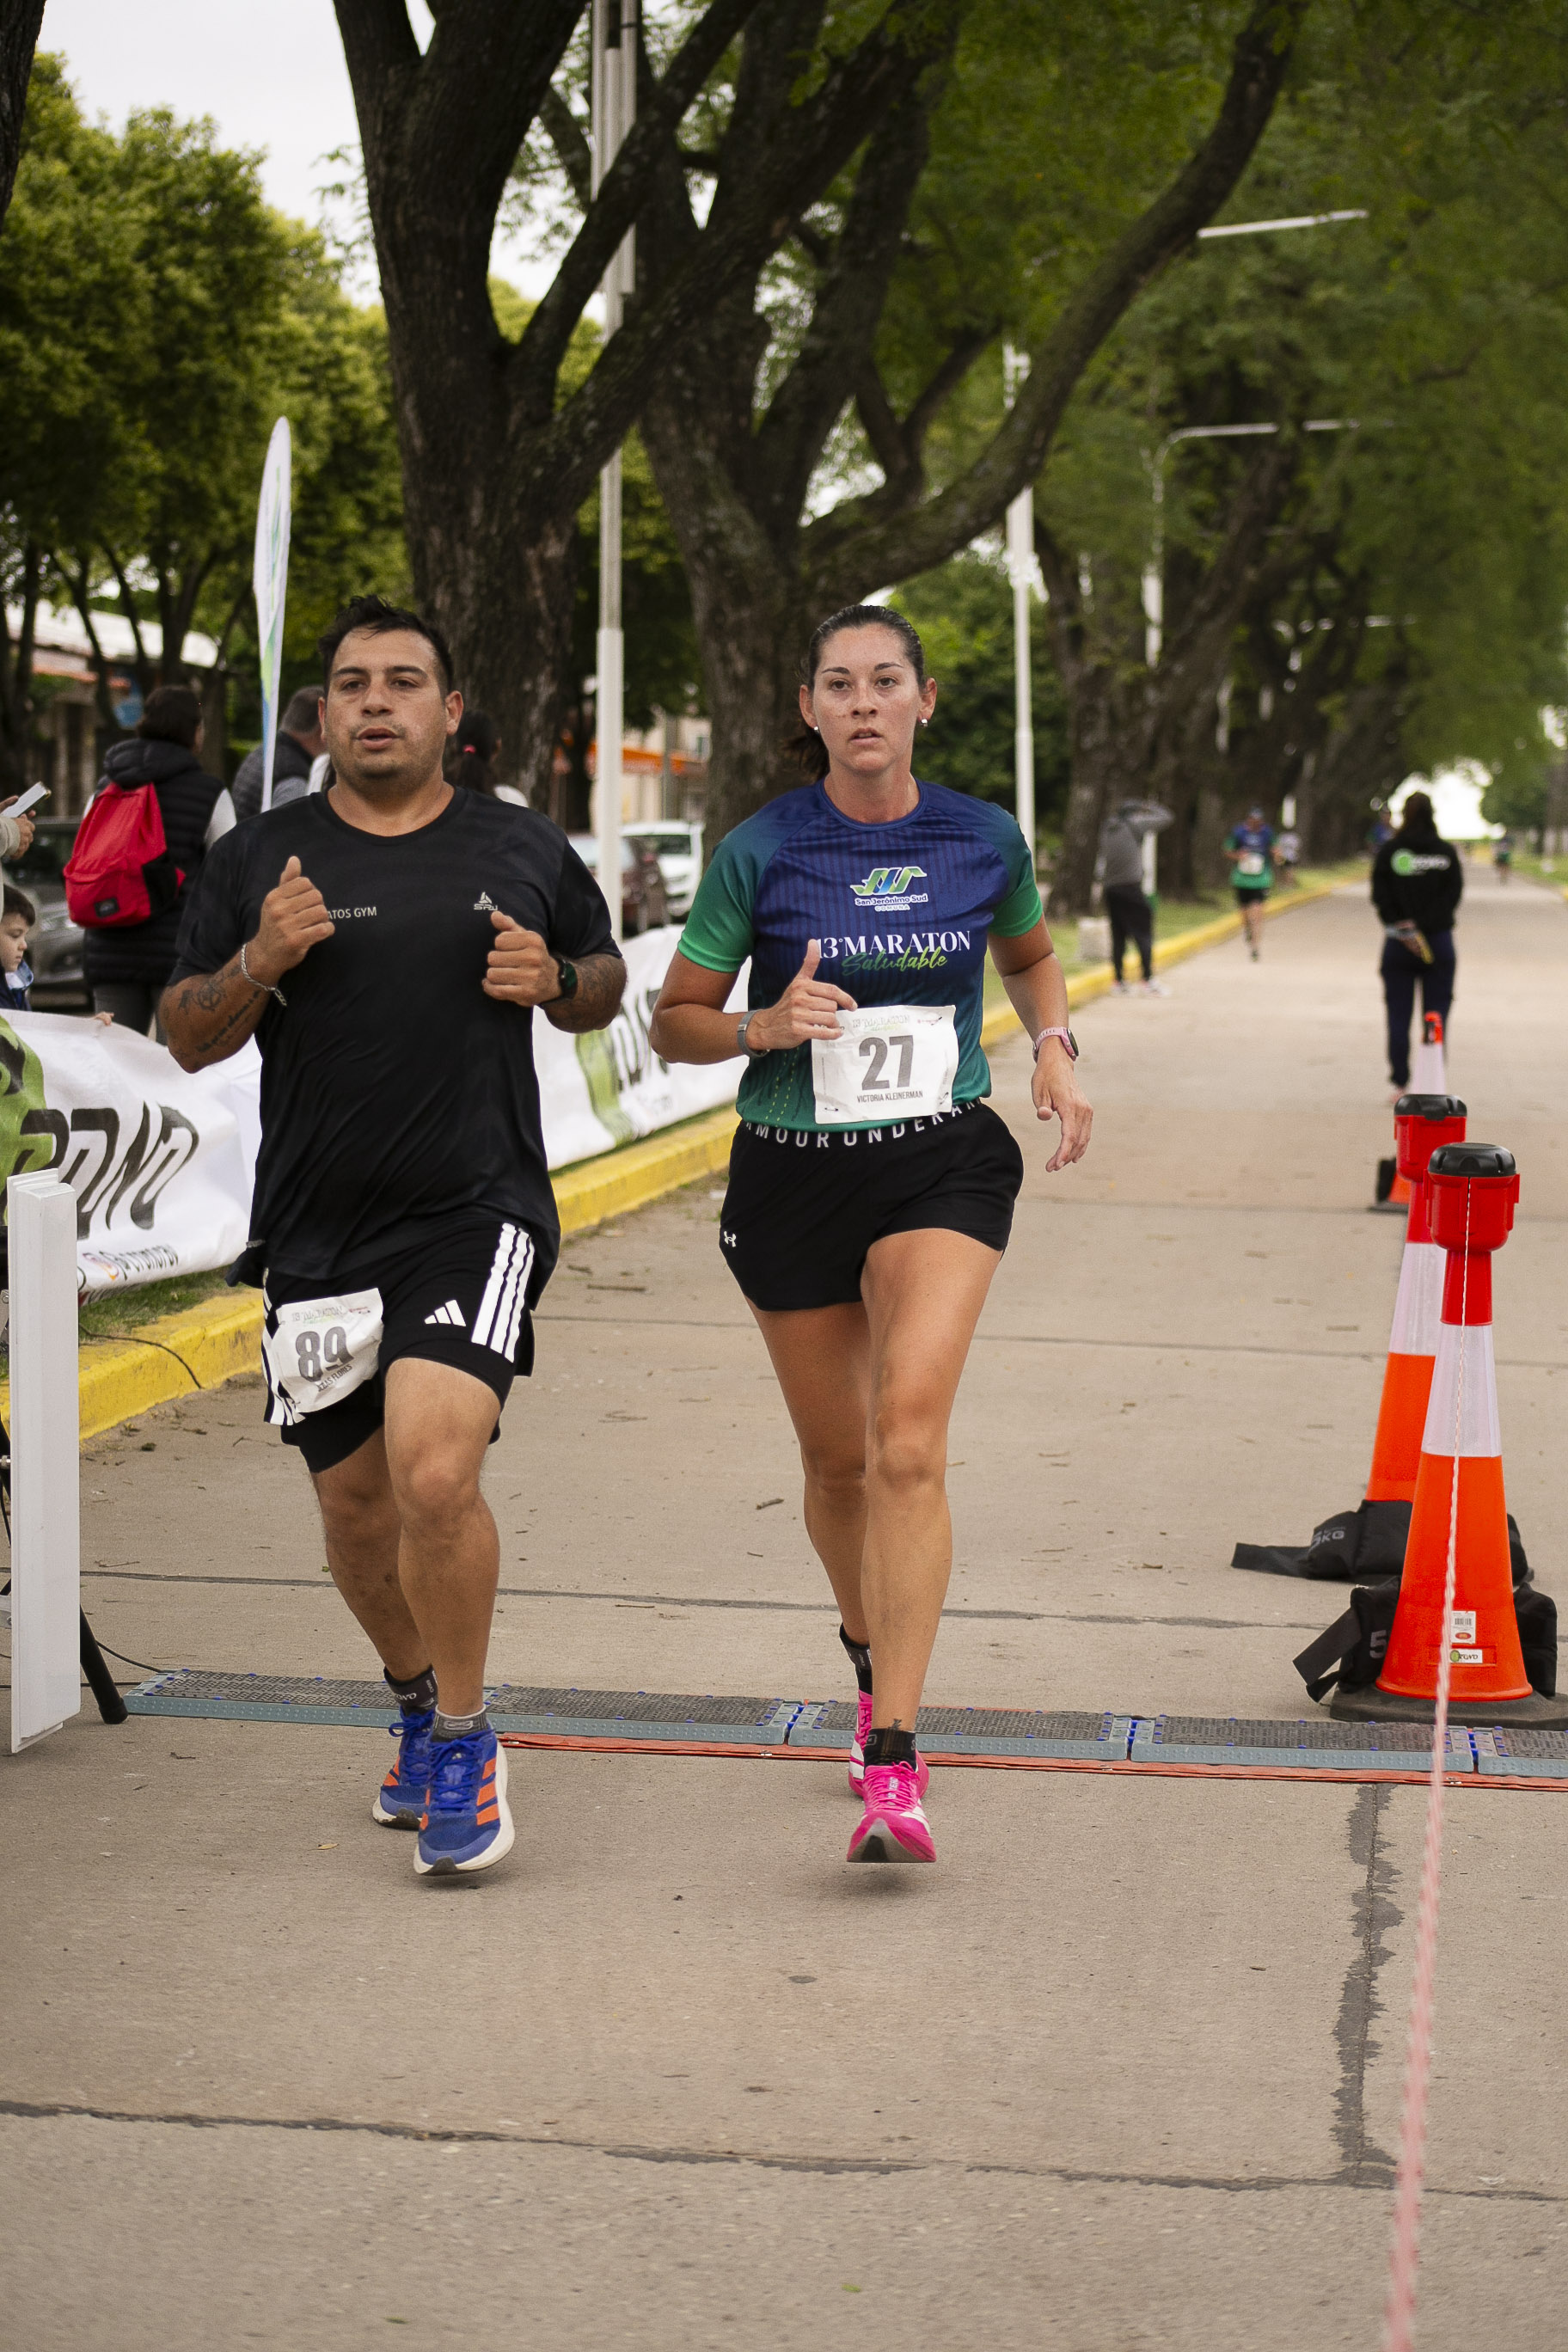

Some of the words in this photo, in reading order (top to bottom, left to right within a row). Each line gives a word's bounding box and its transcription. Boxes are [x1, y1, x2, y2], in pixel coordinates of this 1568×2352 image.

[871, 897, 910, 905] Jerónimo
[911, 894, 928, 903] Sud
[353, 906, 377, 918] GYM
[843, 930, 971, 957] MARATON
[841, 946, 948, 977] Saludable
[858, 1034, 914, 1091] 27
[856, 1093, 885, 1103] VICTORIA
[885, 1090, 923, 1102] KLEINERMAN
[295, 1326, 354, 1382] 89
[332, 1363, 353, 1381] FLORES
